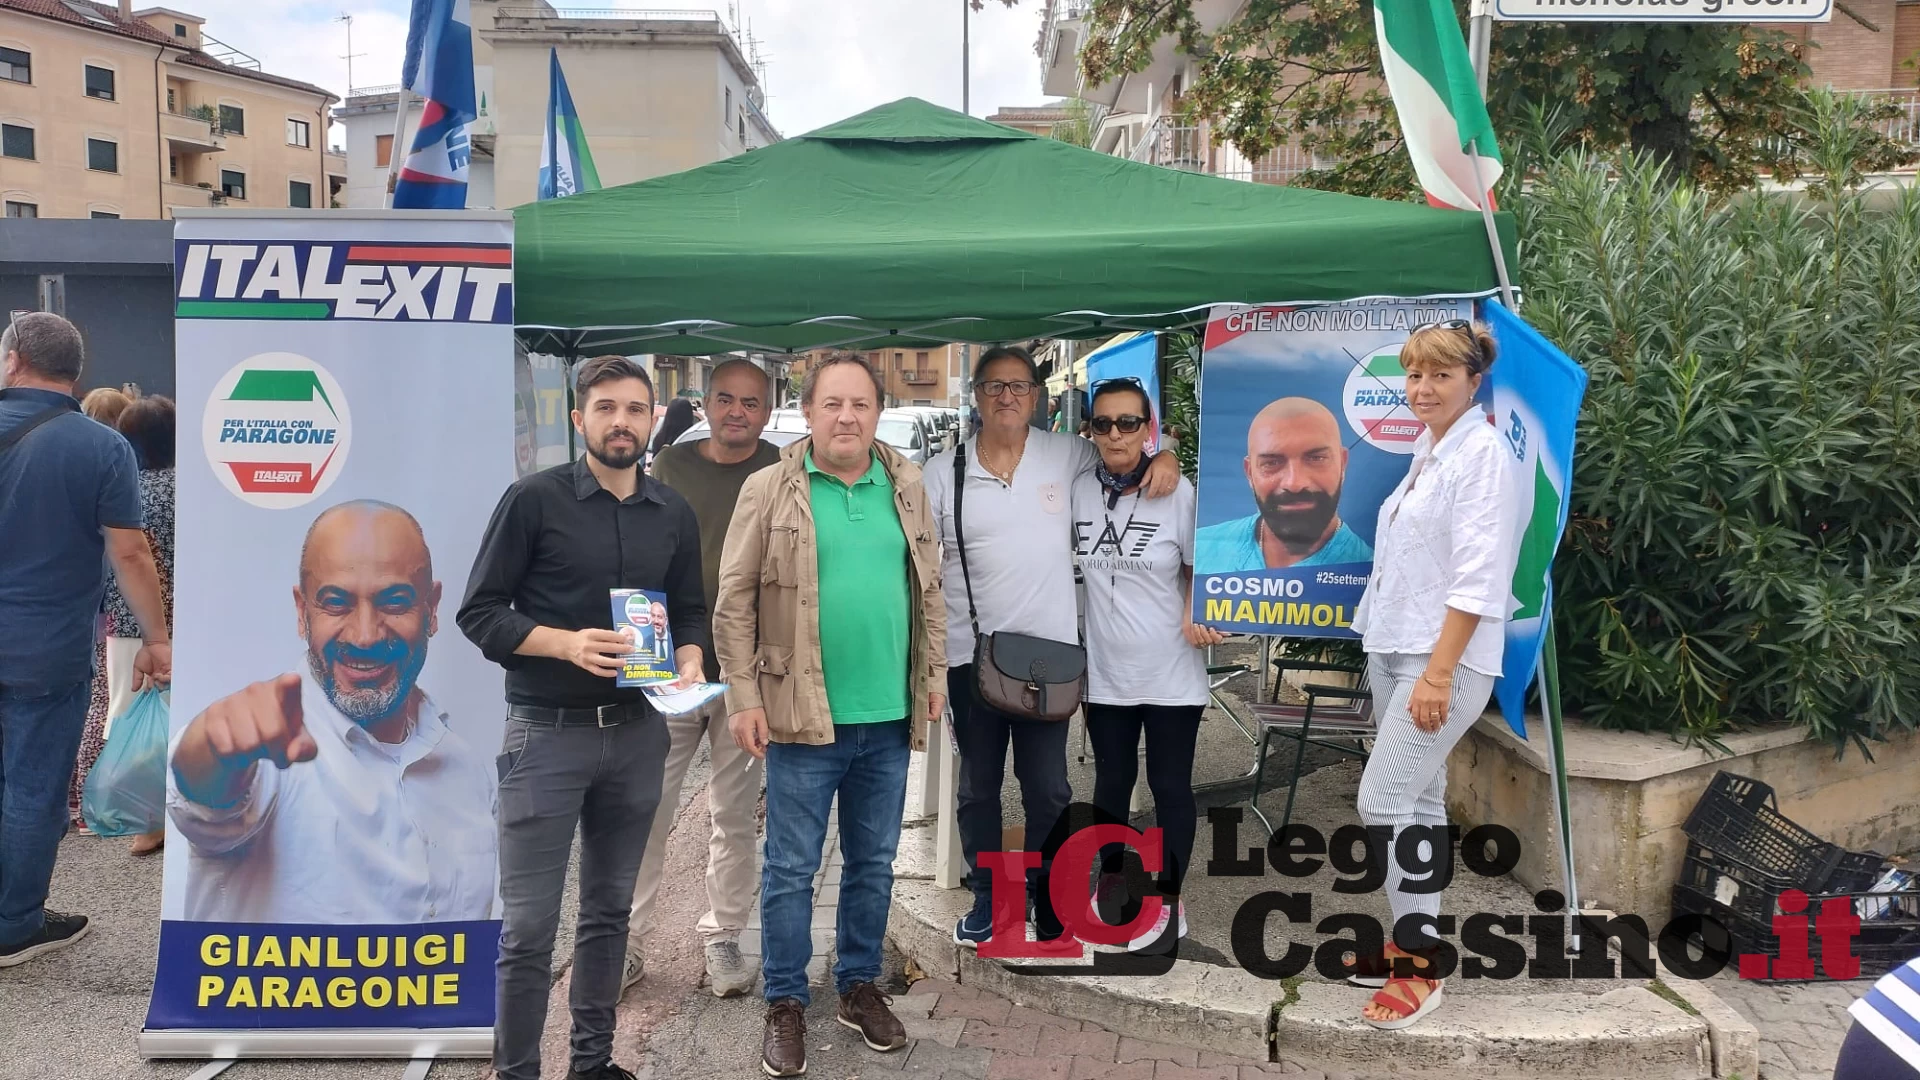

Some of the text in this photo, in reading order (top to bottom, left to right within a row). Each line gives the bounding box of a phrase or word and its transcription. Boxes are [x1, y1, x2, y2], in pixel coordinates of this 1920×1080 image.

[178, 244, 512, 322] ITALEXIT
[1226, 311, 1271, 331] CHE
[1276, 310, 1330, 332] NON
[1331, 309, 1409, 332] MOLLA
[223, 419, 313, 429] PER L'ITALIA CON
[219, 428, 336, 444] PARAGONE
[253, 470, 303, 483] ITALEXIT
[1110, 560, 1153, 571] ARMANI
[1205, 576, 1304, 598] COSMO
[1205, 599, 1359, 628] MAMMOL
[625, 670, 673, 679] DIMENTICO
[200, 933, 466, 968] GIANLUIGI
[198, 973, 459, 1008] PARAGONE
